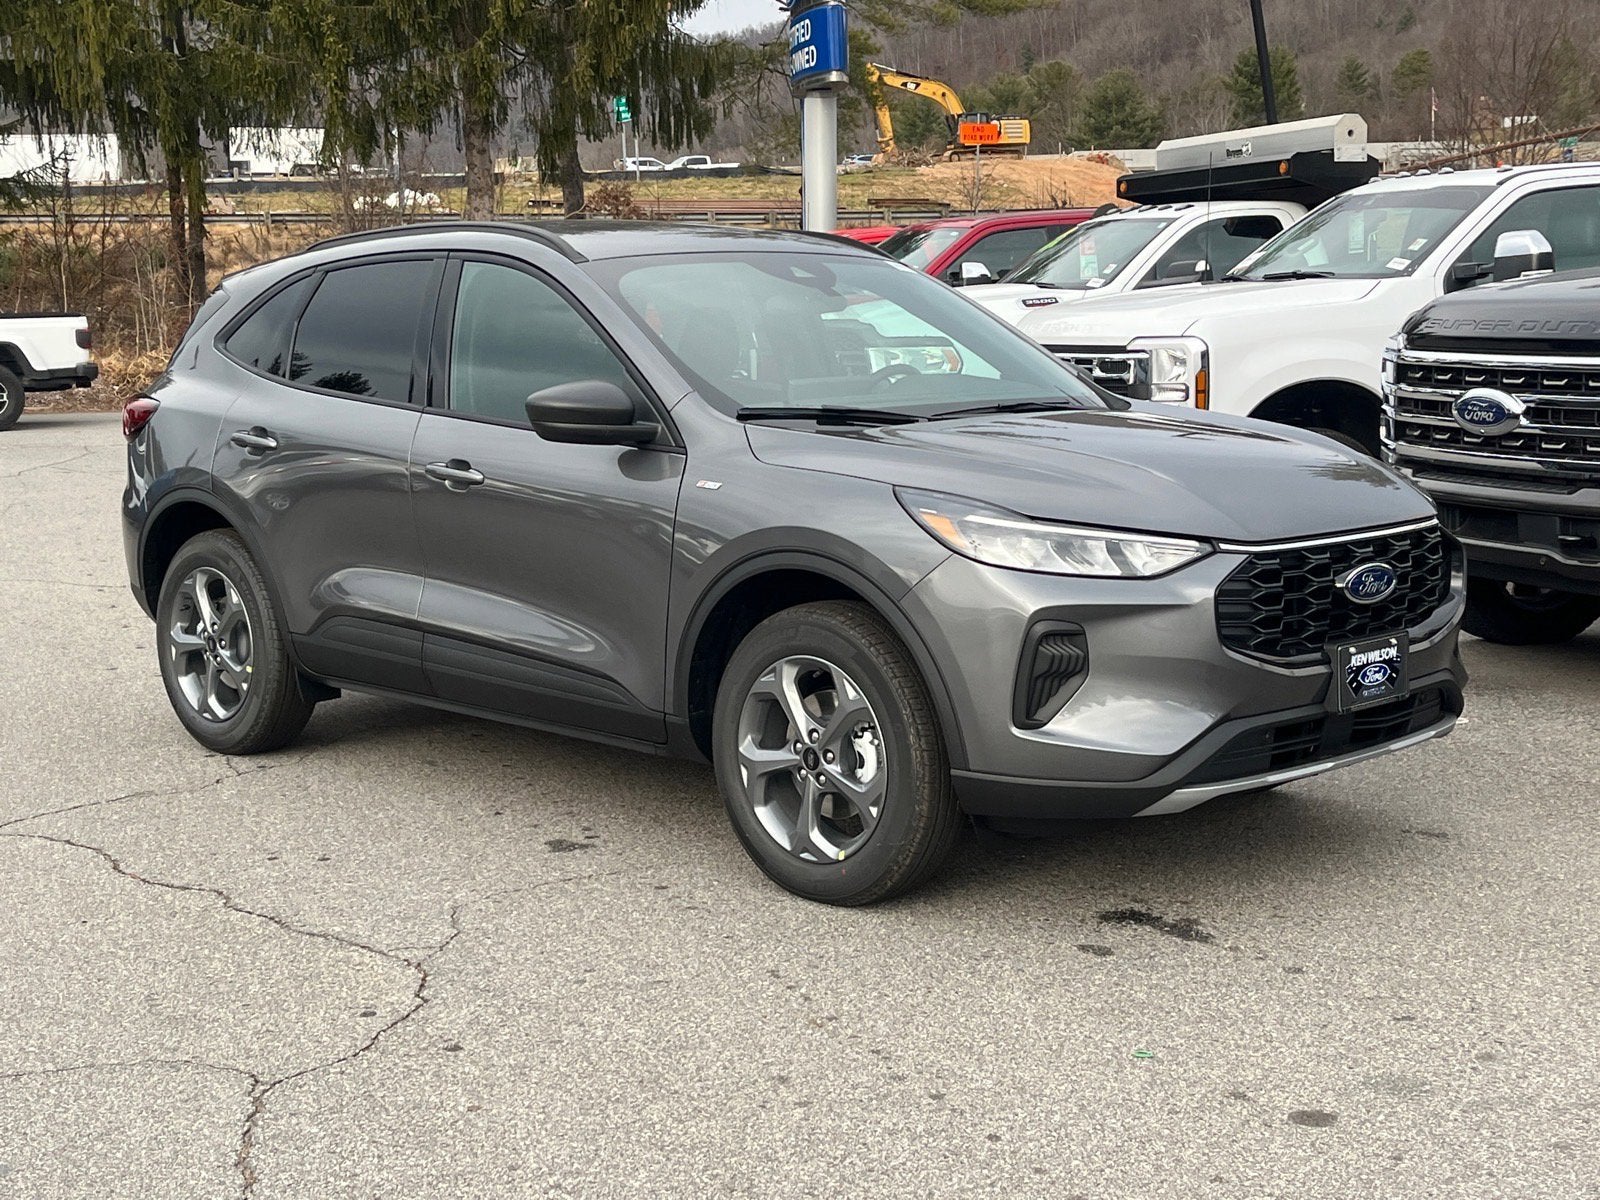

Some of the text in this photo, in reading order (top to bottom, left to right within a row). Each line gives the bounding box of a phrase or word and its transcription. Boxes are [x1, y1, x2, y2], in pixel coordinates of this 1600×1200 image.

[980, 134, 994, 142] WORK
[1425, 318, 1511, 332] SUPER
[1464, 400, 1496, 421] Ford
[1359, 571, 1388, 595] Ford
[1351, 646, 1397, 667] KEN WILSON
[1364, 666, 1384, 682] Ford
